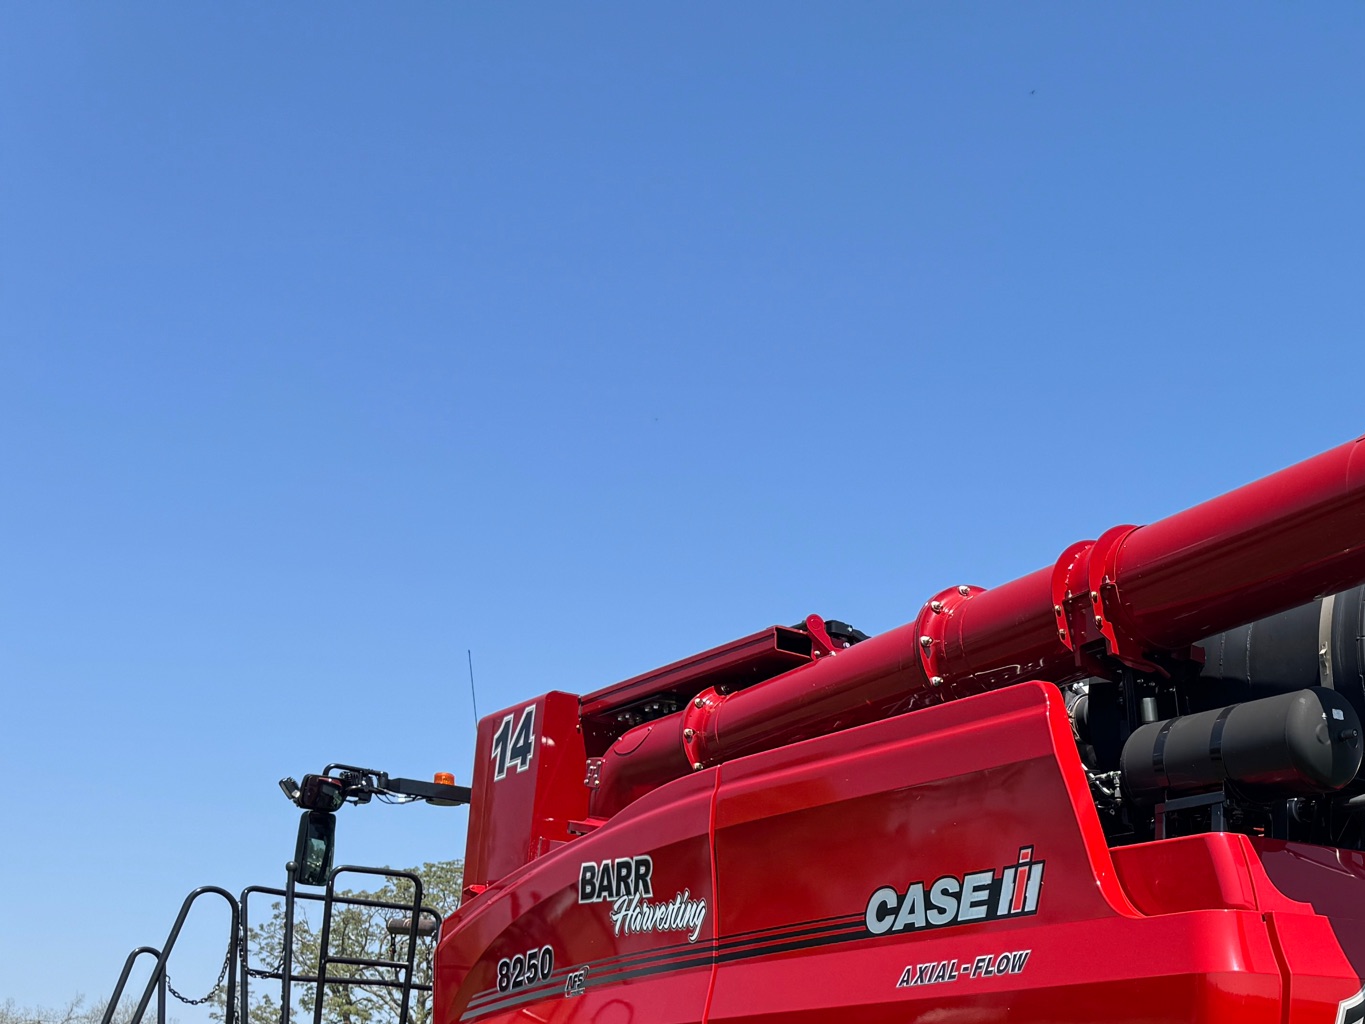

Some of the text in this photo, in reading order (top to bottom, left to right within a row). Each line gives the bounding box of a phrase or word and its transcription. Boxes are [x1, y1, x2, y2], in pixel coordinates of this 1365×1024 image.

[491, 703, 536, 782] 14
[578, 854, 653, 904] BARR
[865, 871, 994, 934] CASE
[610, 888, 707, 943] Harvesting
[497, 944, 554, 992] 8250
